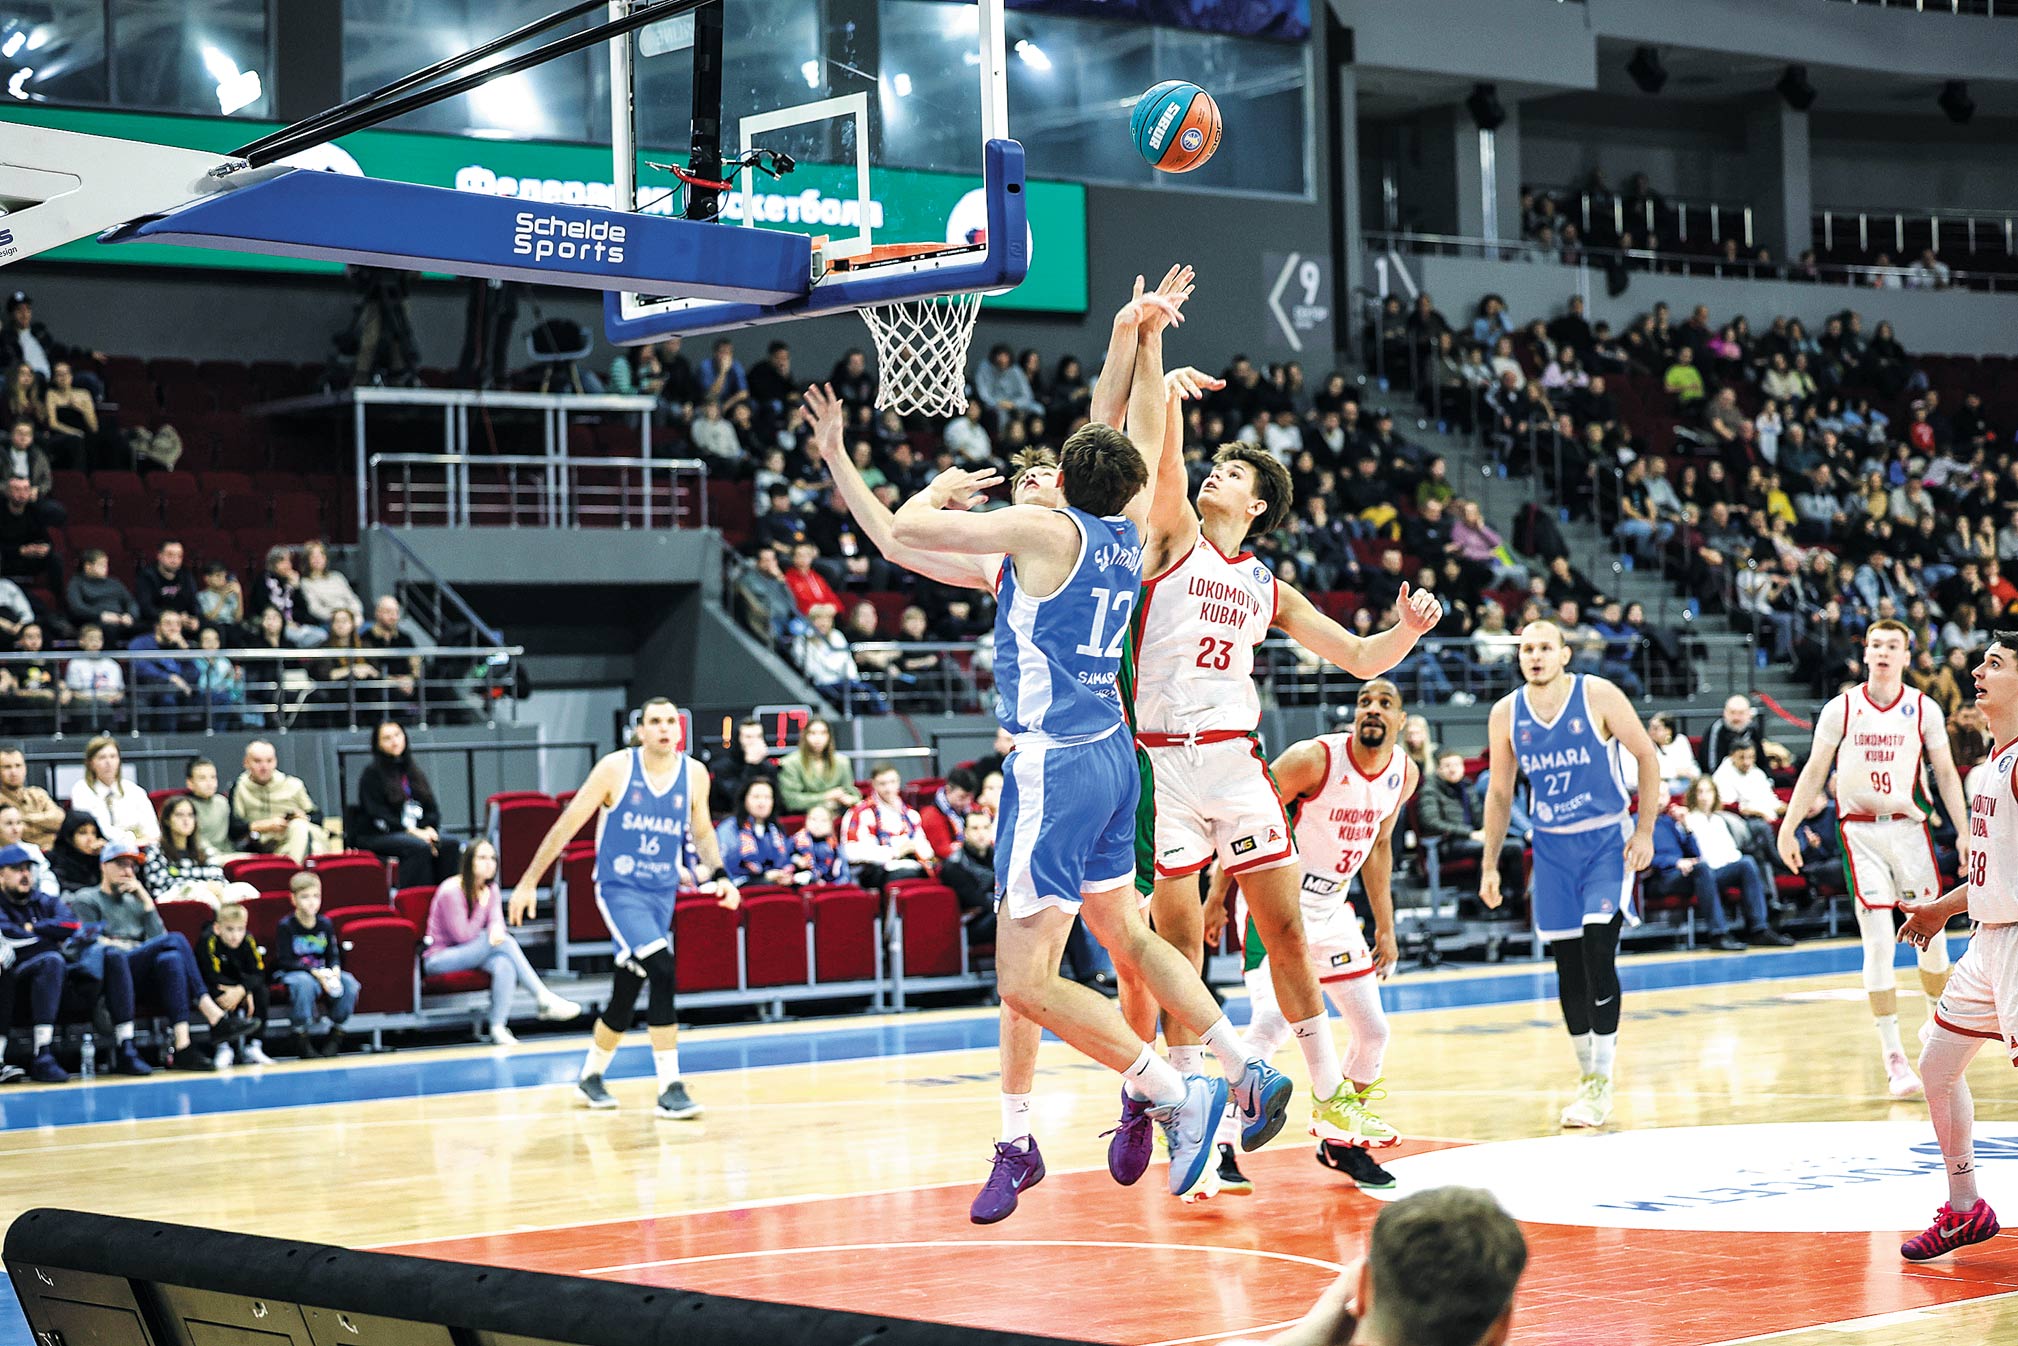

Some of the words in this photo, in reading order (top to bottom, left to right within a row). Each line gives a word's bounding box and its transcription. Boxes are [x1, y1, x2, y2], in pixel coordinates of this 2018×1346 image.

[718, 187, 884, 228] скетбола
[515, 212, 626, 243] Schelde
[0, 246, 18, 257] esign
[513, 233, 624, 263] Sports
[1300, 261, 1320, 305] 9
[1075, 587, 1134, 658] 12
[1199, 601, 1247, 630] KUBAN
[1195, 636, 1234, 671] 23
[1077, 670, 1119, 686] SAMAR
[1520, 745, 1592, 775] SAMARA
[1544, 770, 1572, 797] 27
[1870, 771, 1892, 795] 99
[621, 811, 682, 837] SAMARA
[1971, 816, 1989, 838] UBA
[637, 833, 661, 856] 16
[1335, 849, 1363, 874] 32
[1969, 849, 1987, 887] 38
